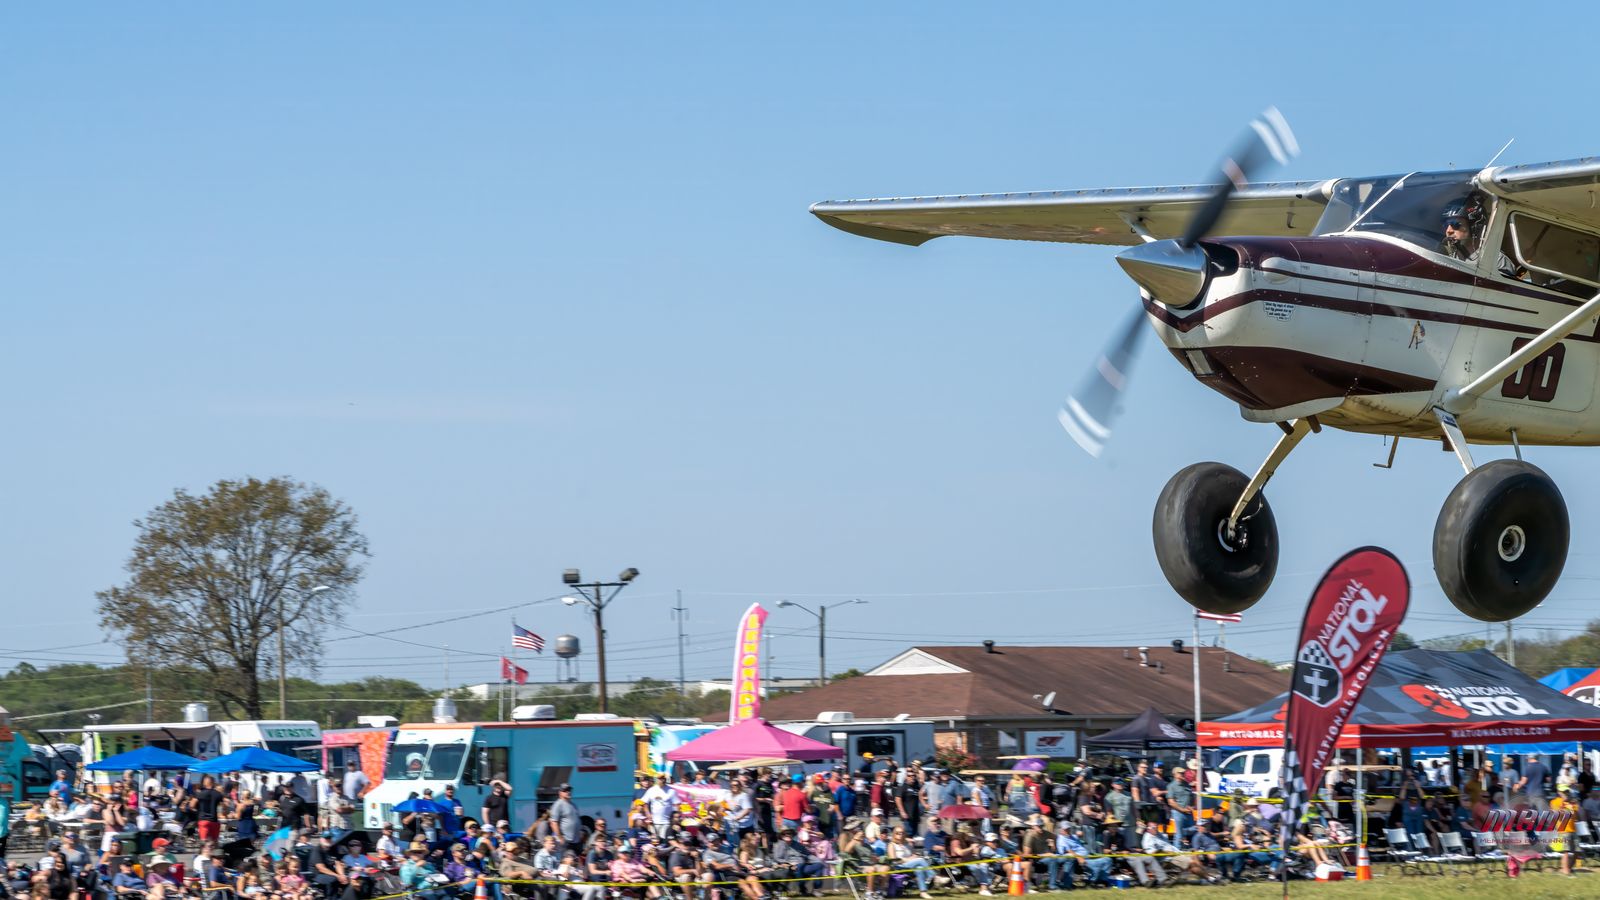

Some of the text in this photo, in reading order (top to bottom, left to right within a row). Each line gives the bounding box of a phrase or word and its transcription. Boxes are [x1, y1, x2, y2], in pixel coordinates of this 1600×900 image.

[1317, 579, 1364, 645] NATIONAL
[1328, 587, 1389, 669] STOL
[1312, 629, 1391, 769] NATIONALSTOL.COM
[1450, 686, 1519, 696] NATIONAL
[1461, 696, 1550, 716] STOL
[1219, 730, 1284, 739] NATIONALS
[1451, 727, 1551, 738] NATIONALSTOL.COM
